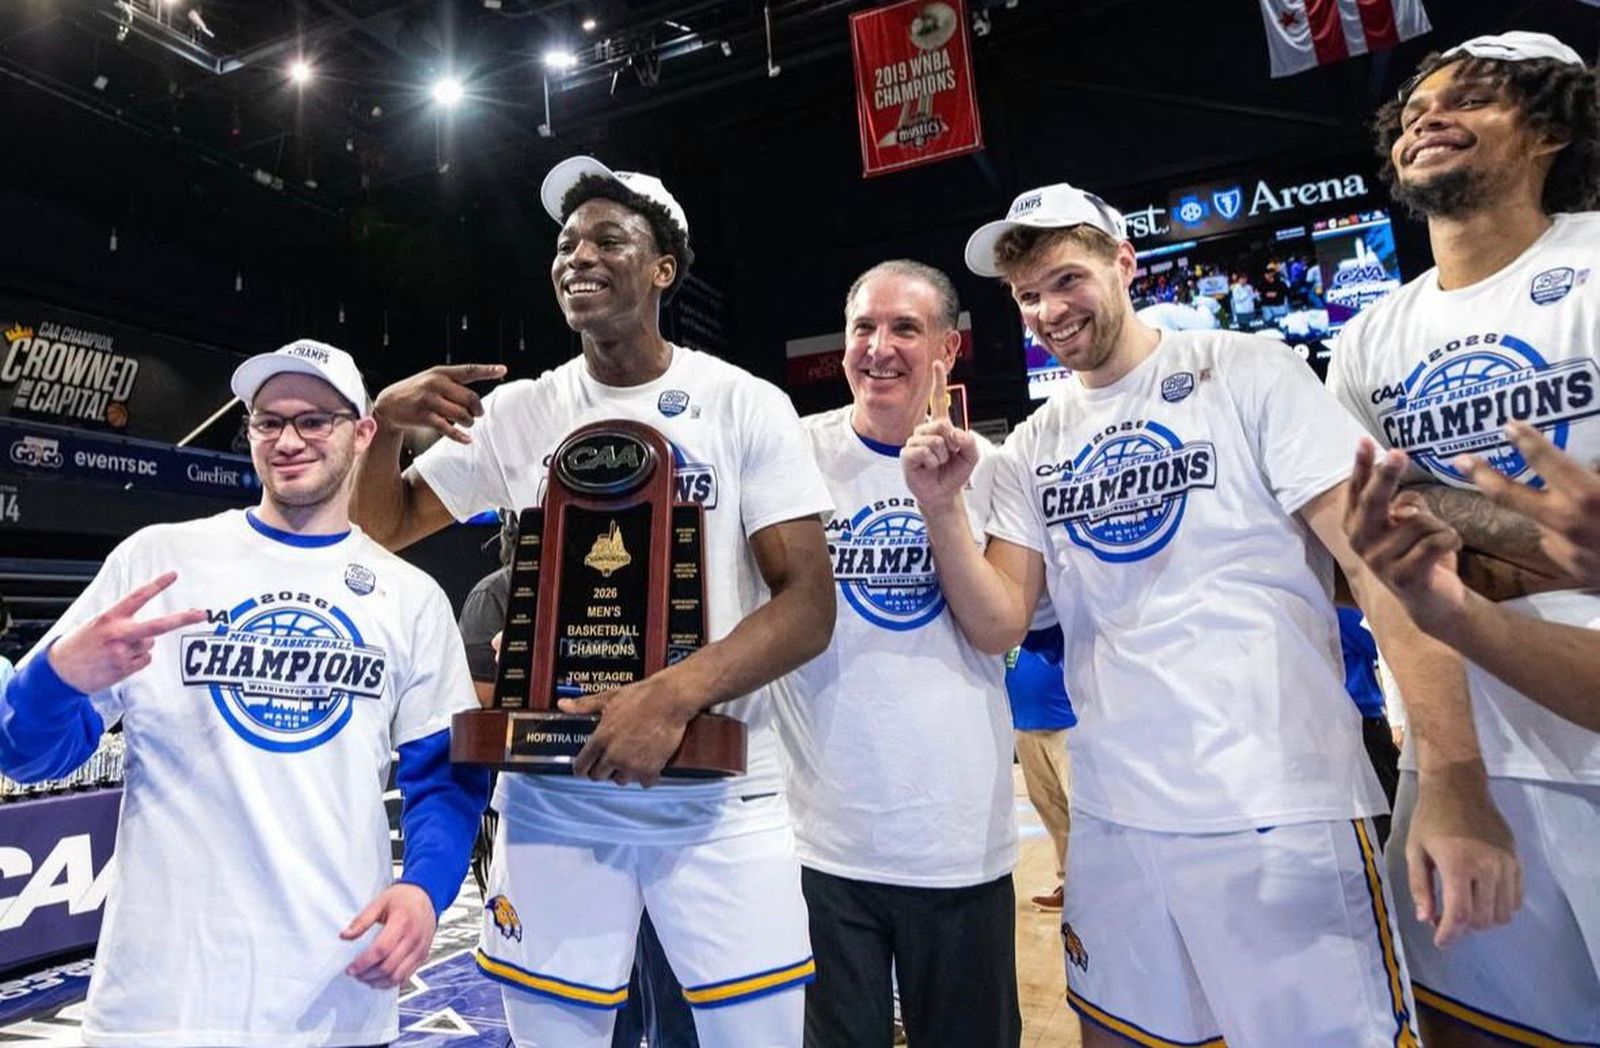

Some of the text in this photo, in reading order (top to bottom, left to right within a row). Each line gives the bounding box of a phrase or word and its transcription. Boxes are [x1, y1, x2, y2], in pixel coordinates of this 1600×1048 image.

[874, 48, 951, 88] 2019 WNBA
[874, 69, 956, 111] CHAMPIONS
[1249, 174, 1368, 216] Arena
[38, 321, 61, 340] CAA
[293, 347, 330, 364] CHAMPS
[1427, 332, 1498, 364] 2026
[1, 337, 138, 402] CROWNED
[1370, 381, 1407, 406] CAA
[1408, 370, 1534, 412] MEN'S BASKETBALL
[29, 381, 110, 421] CAPITAL
[1383, 370, 1593, 449] CHAMPIONS
[567, 444, 640, 471] CAA
[1036, 460, 1074, 477] CAA
[1042, 451, 1209, 519] CHAMPIONS
[824, 519, 852, 532] AA
[259, 591, 329, 610] 2026
[593, 587, 618, 599] 2026
[587, 606, 621, 618] MEN'S
[567, 624, 639, 637] BASKETBALL
[228, 632, 354, 651] MEN'S BASKETBALL
[569, 643, 635, 656] CHAMPIONS
[185, 640, 385, 689] CHAMPIONS
[567, 671, 634, 682] TOM YEAGER
[263, 712, 309, 723] MARCH
[526, 733, 572, 744] HOFSTRA
